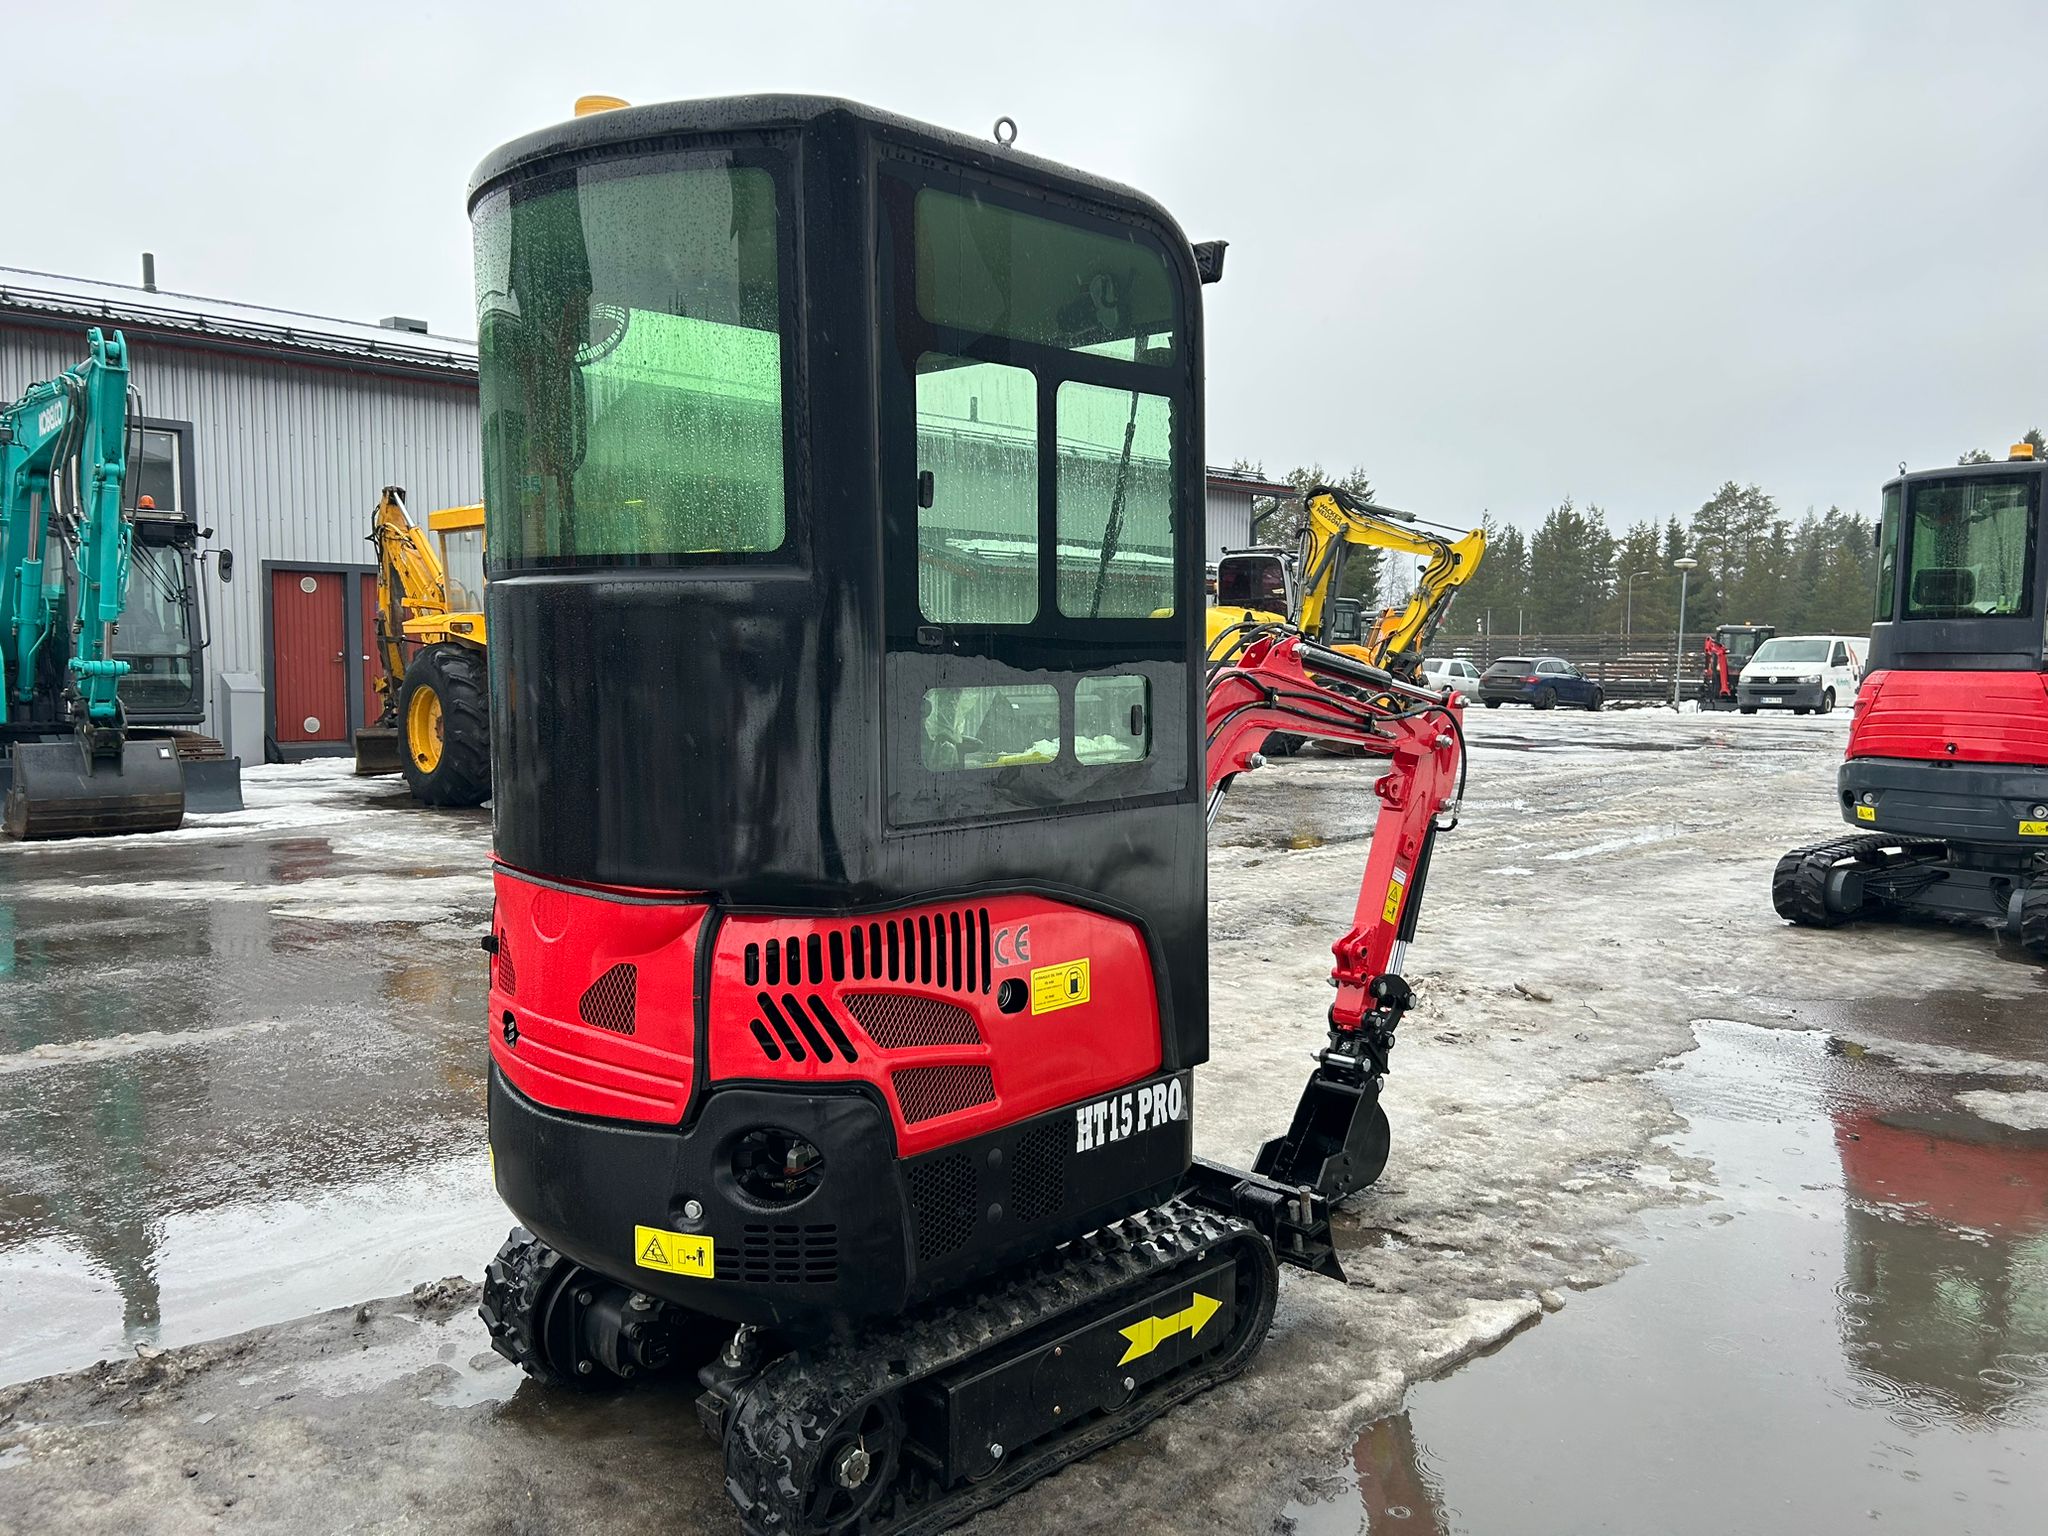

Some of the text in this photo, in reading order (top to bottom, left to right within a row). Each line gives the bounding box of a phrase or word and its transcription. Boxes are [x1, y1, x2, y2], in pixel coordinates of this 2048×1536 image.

[38, 400, 63, 437] KOBELCO
[1316, 507, 1340, 527] NEUSON
[1319, 501, 1342, 521] WACKER
[994, 925, 1029, 965] CE
[1076, 1078, 1182, 1153] HT15 PRO
